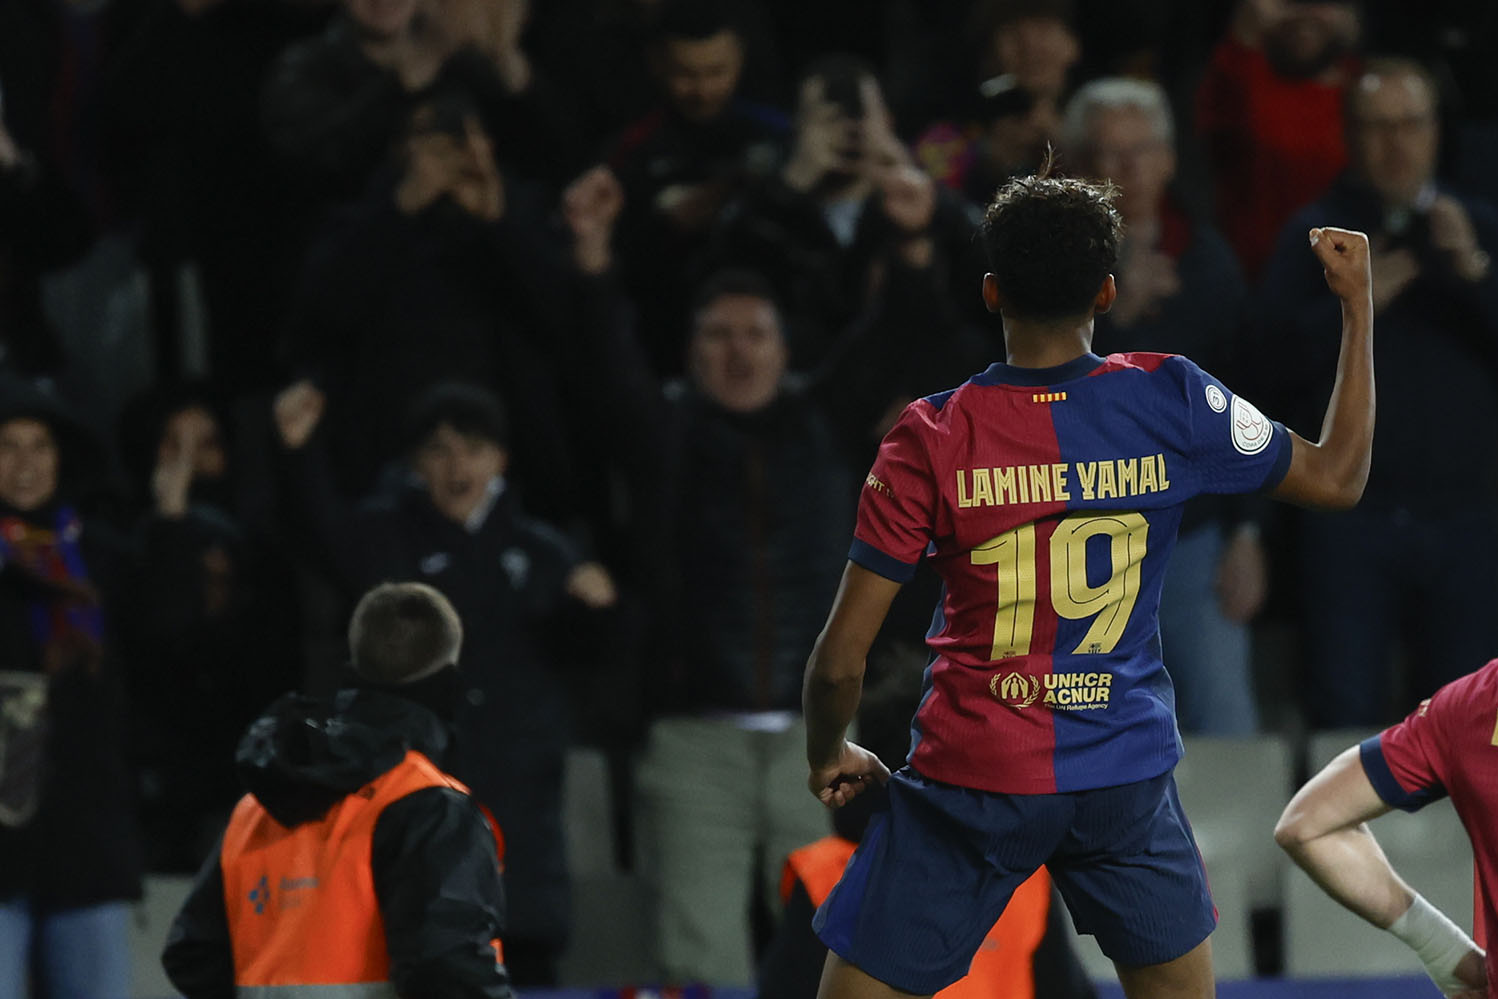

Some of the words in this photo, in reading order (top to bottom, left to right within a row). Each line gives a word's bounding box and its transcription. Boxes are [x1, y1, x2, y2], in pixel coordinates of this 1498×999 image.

[956, 463, 1071, 508] LAMINE
[1076, 453, 1171, 500] YAMAL
[970, 510, 1149, 661] 19
[1042, 687, 1111, 705] ACNUR
[1043, 672, 1113, 690] UNHCR
